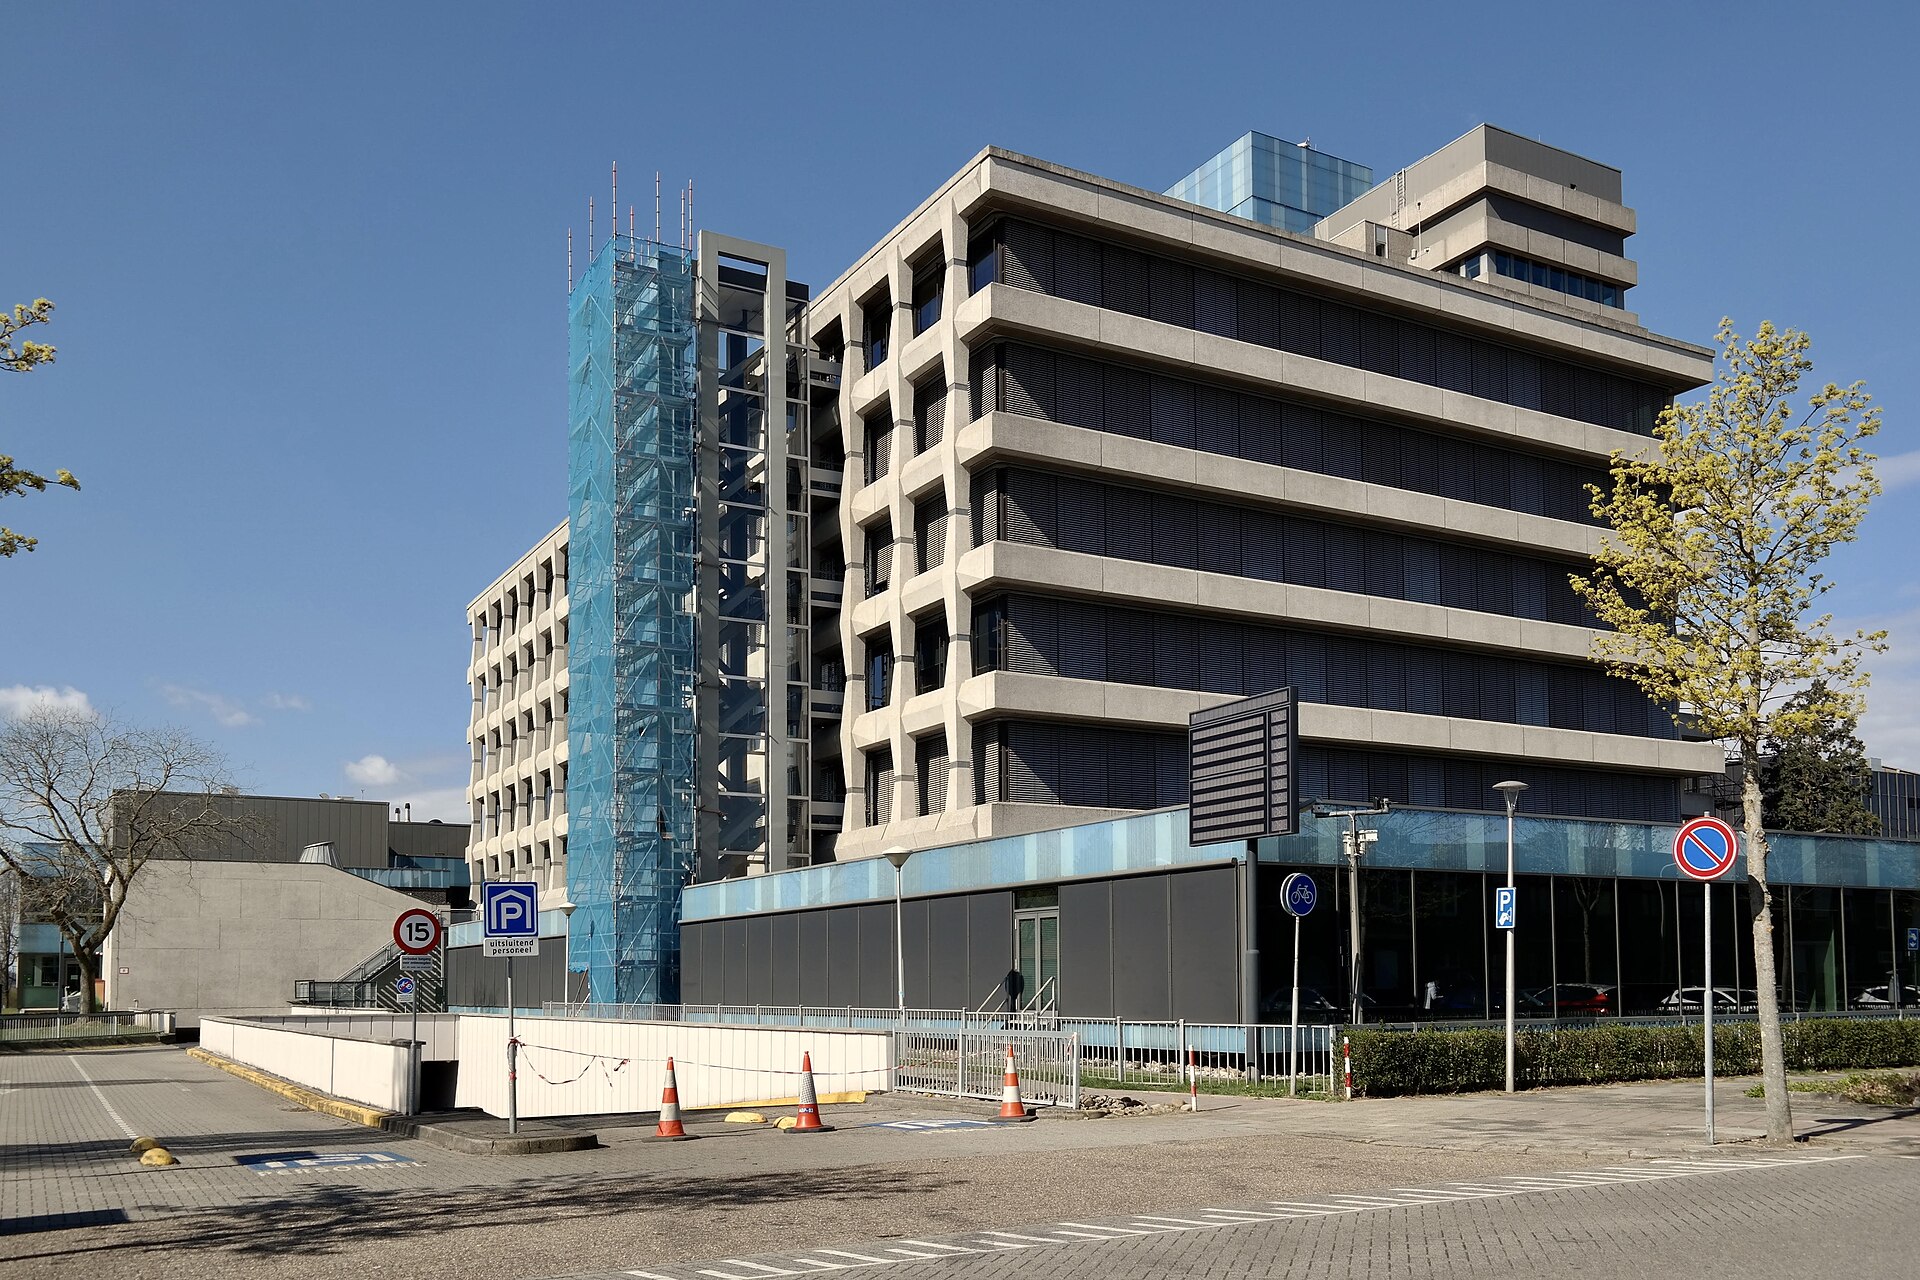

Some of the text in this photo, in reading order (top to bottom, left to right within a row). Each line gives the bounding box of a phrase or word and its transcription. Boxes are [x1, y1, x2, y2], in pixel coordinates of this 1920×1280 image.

[1500, 891, 1511, 911] P
[501, 902, 522, 929] P
[406, 922, 430, 941] 15
[490, 939, 534, 947] uitsluitend
[492, 947, 532, 955] personeel
